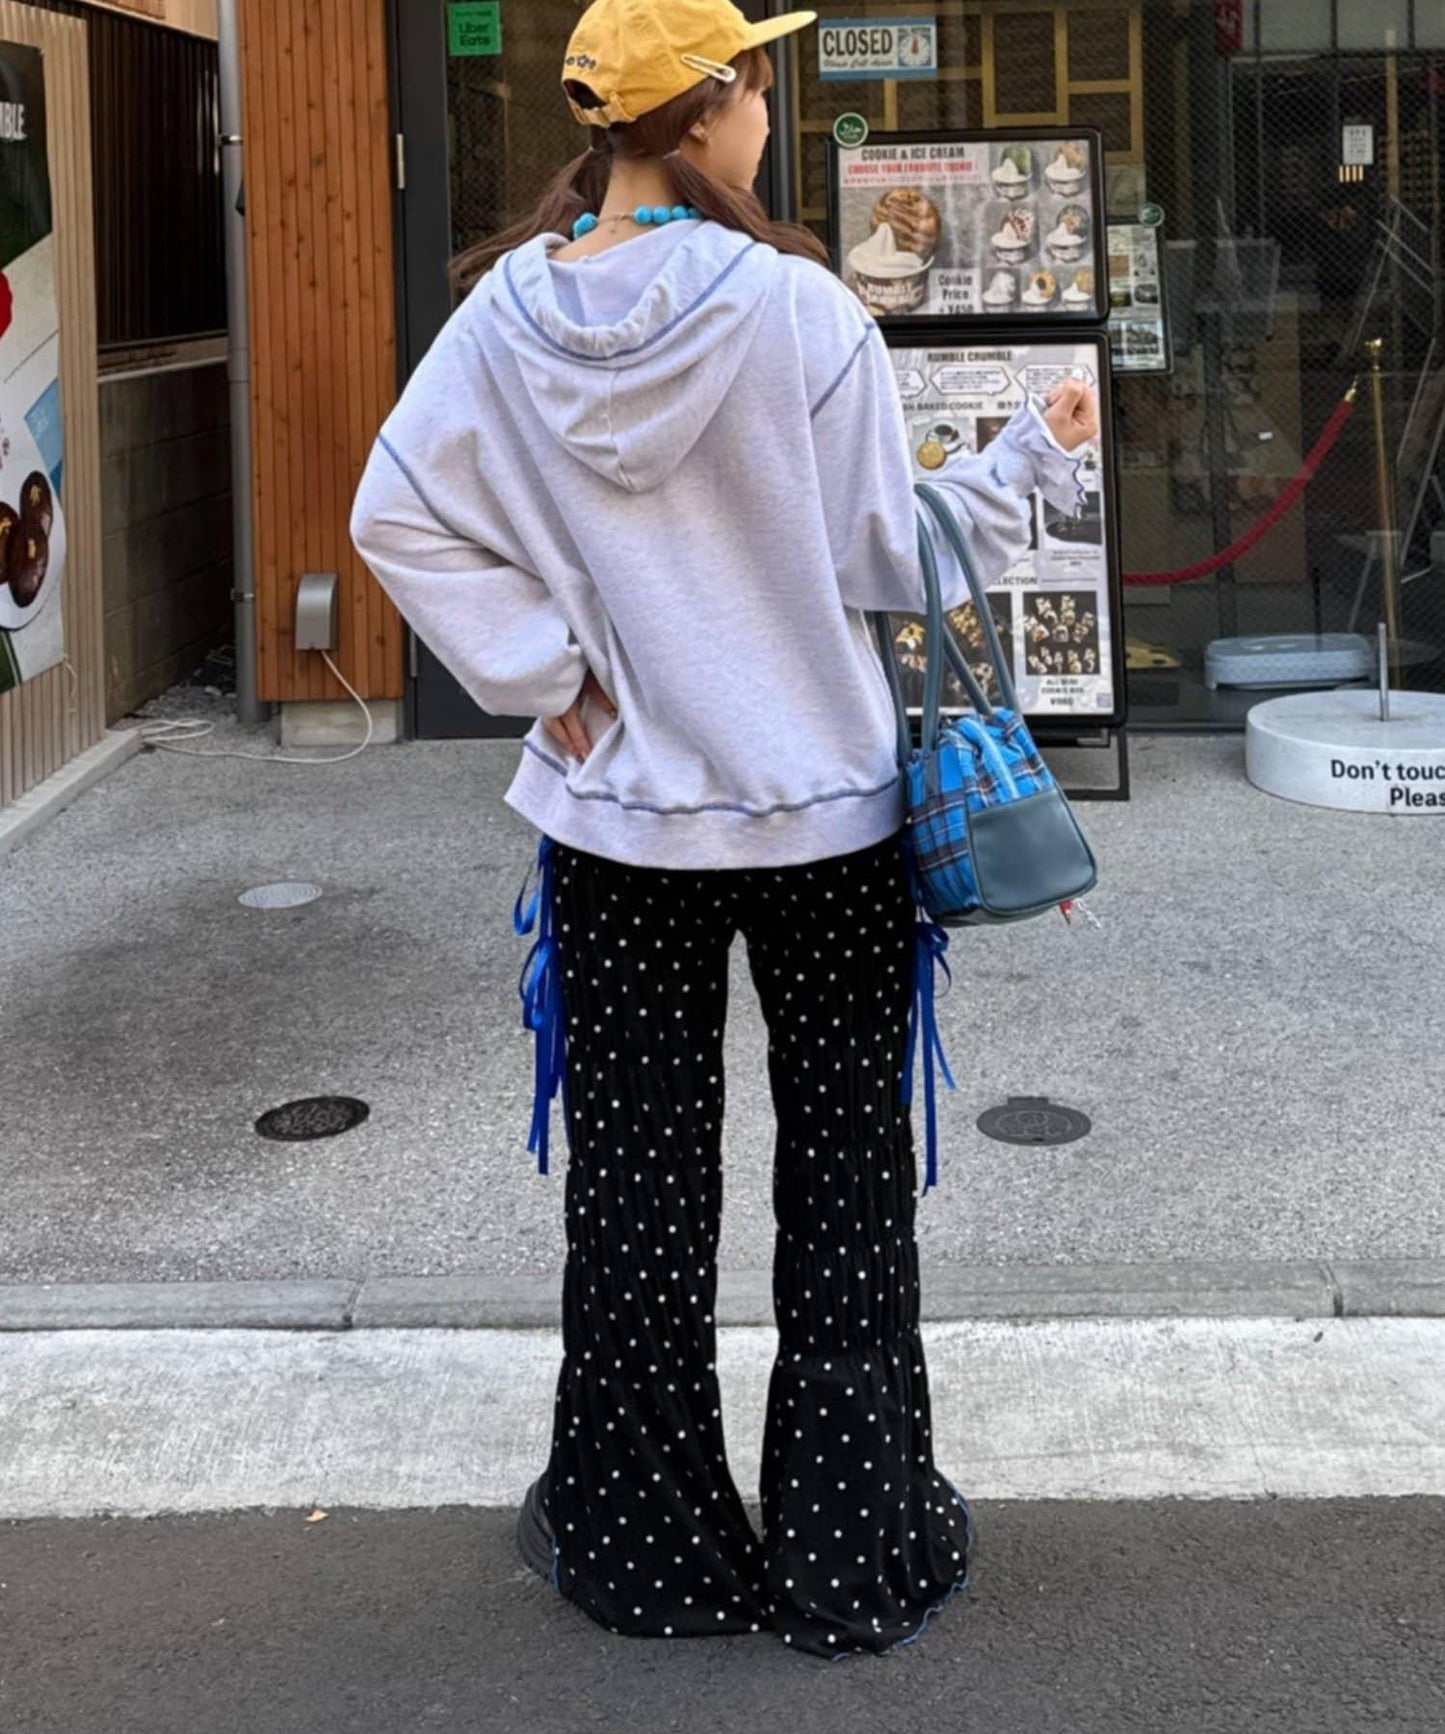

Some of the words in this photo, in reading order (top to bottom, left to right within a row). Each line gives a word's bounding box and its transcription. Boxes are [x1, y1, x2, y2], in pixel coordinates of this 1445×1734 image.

[459, 22, 489, 33] Uber
[460, 35, 490, 46] Eats
[823, 28, 892, 57] CLOSED
[862, 148, 898, 161] COOKIE
[911, 148, 927, 159] ICE
[930, 146, 966, 159] CREAM
[938, 275, 974, 286] Cookie
[943, 289, 969, 301] Price
[928, 352, 966, 363] RUMBLE
[968, 350, 1012, 362] CRUMBLE
[918, 402, 949, 411] BAKED
[949, 401, 983, 410] COOKIE
